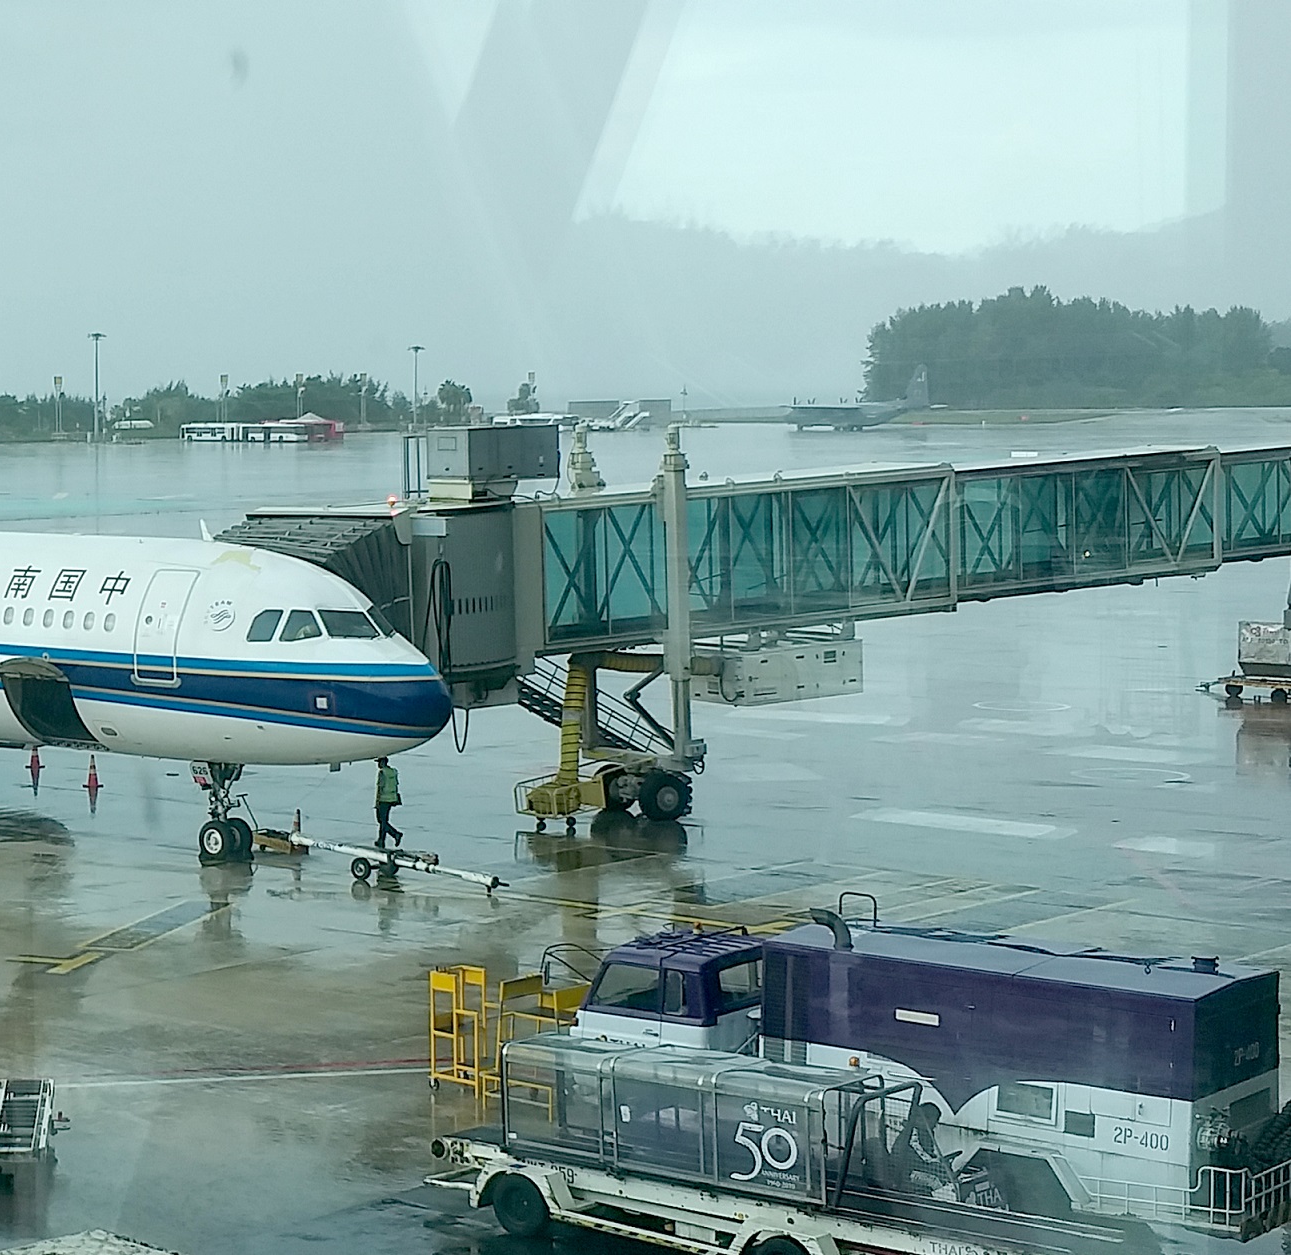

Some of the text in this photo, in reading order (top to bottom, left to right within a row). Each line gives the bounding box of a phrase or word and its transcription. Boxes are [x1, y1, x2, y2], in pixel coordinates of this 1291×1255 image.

[760, 1106, 797, 1125] THAI
[1113, 1125, 1170, 1151] 2P-400
[730, 1122, 798, 1181] 50
